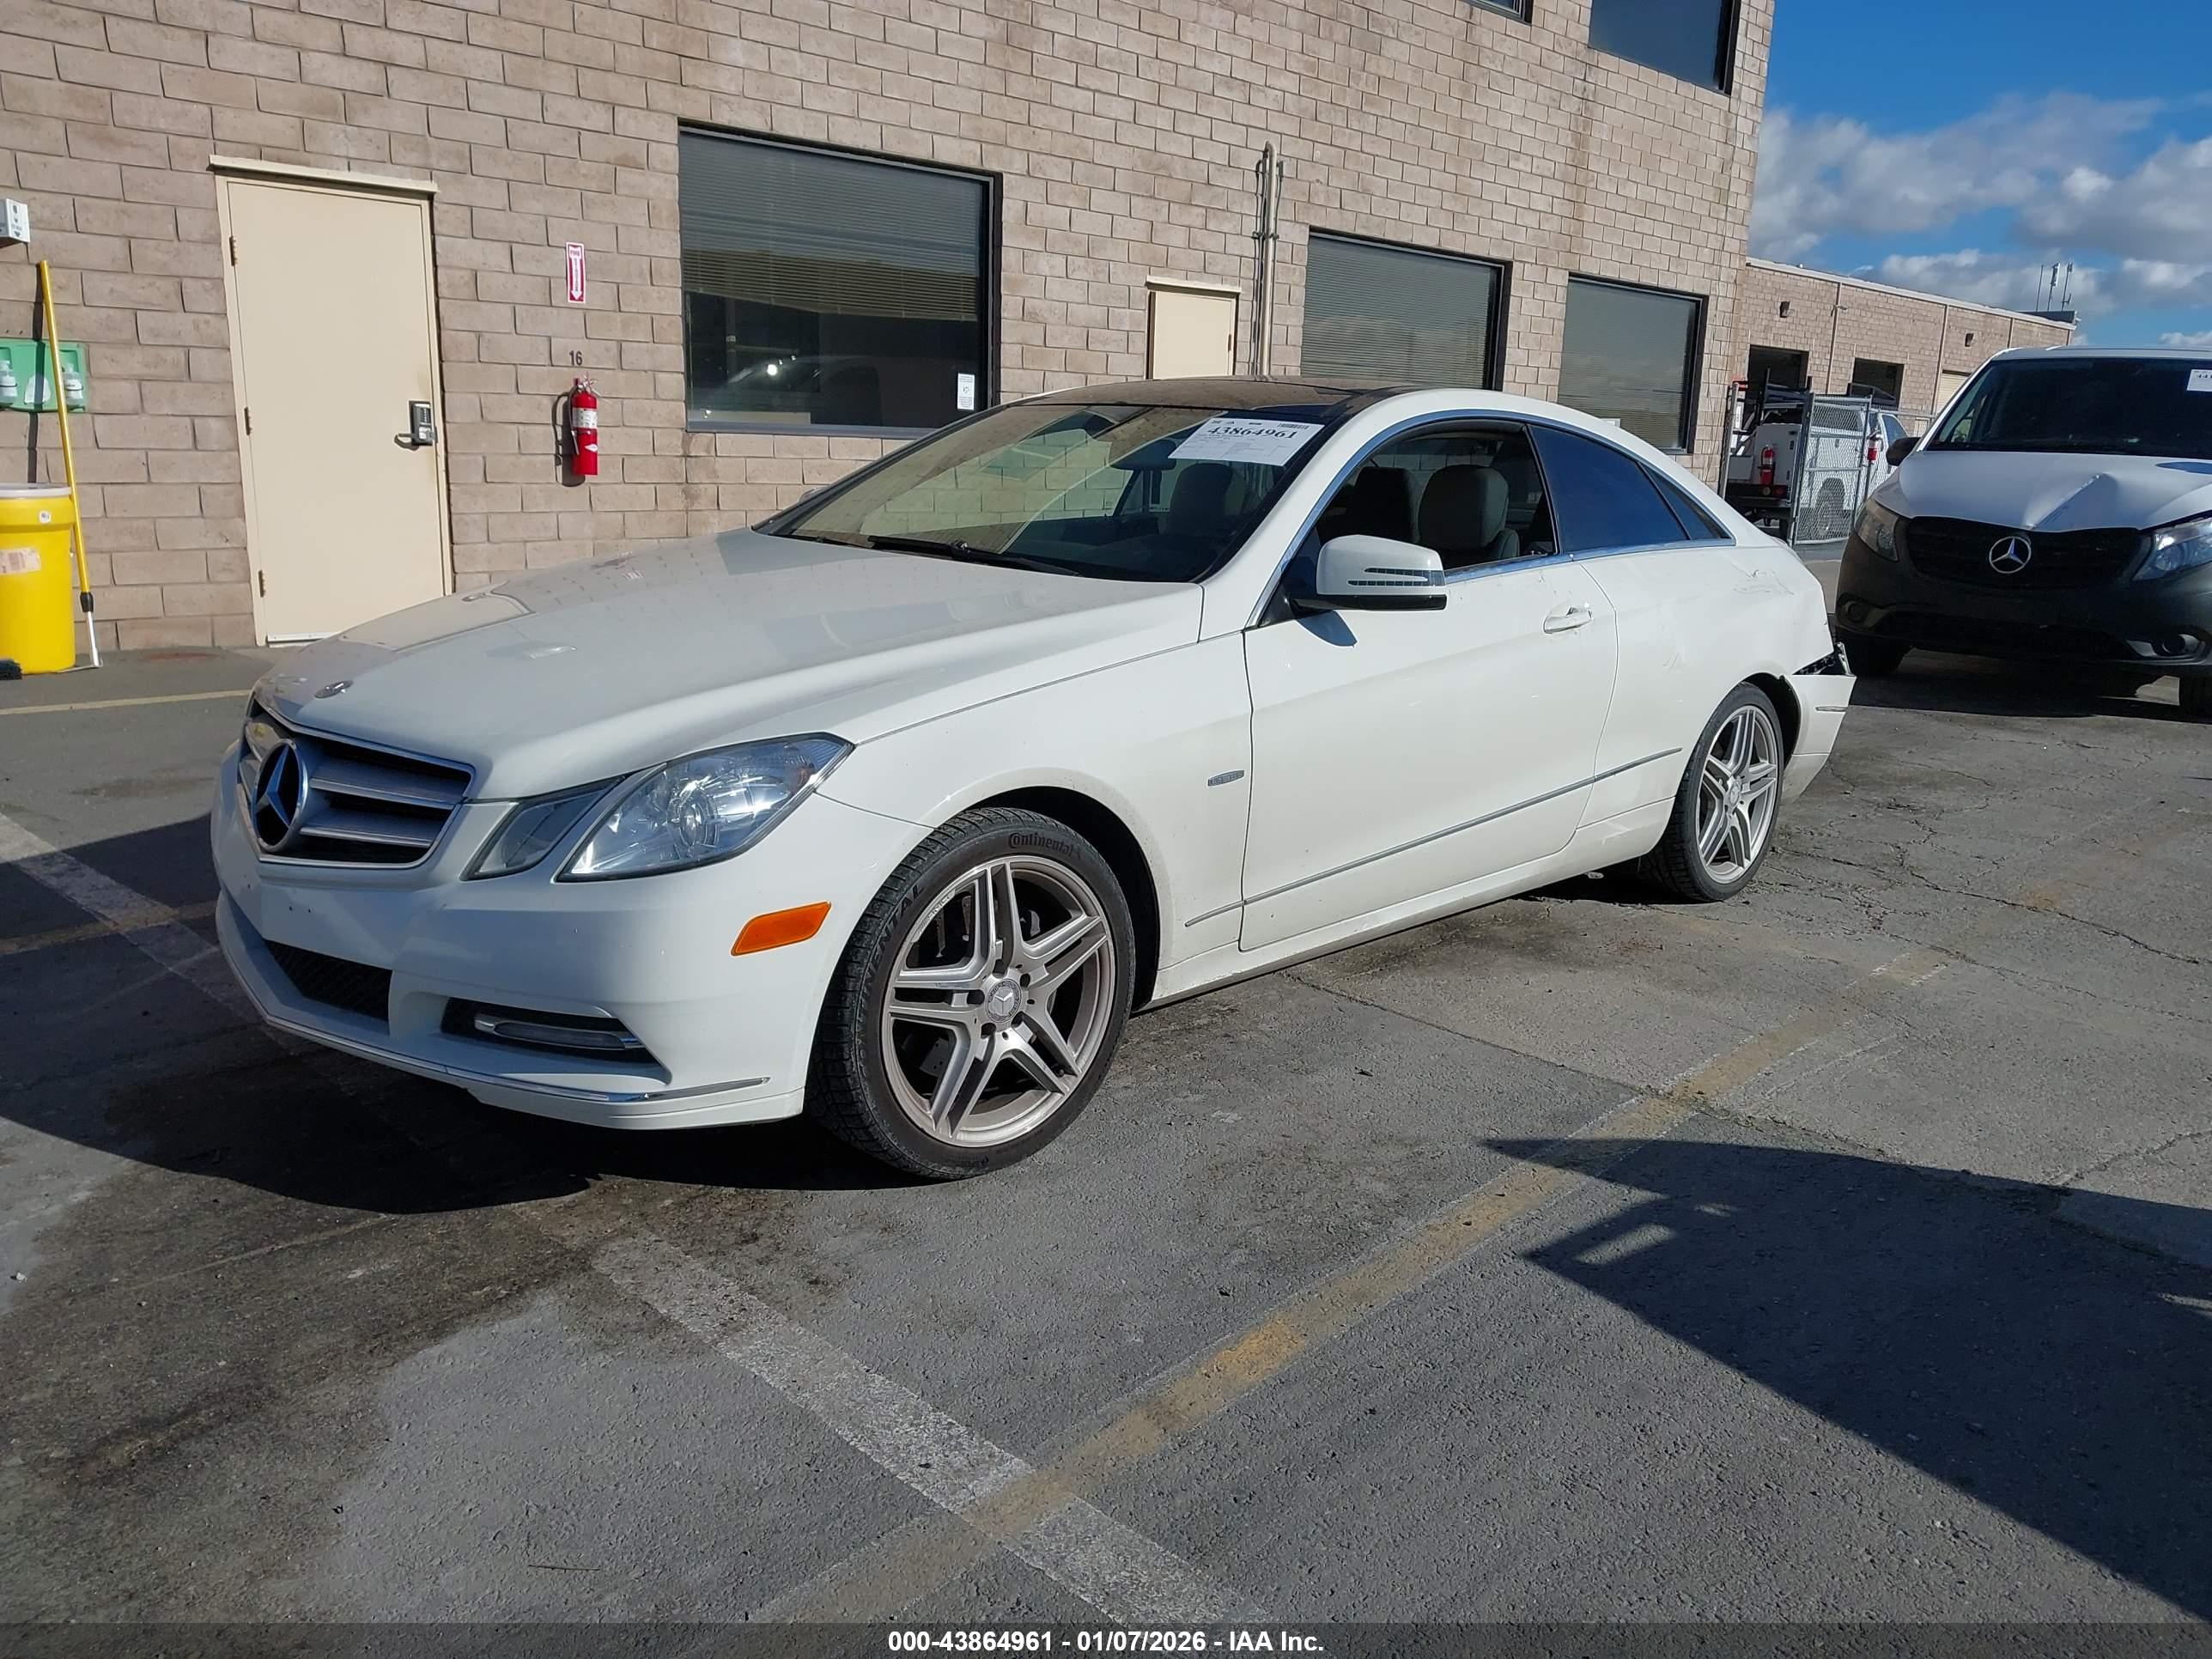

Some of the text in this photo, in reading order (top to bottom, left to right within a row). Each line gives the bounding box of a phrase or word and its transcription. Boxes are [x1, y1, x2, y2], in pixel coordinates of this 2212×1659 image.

[569, 349, 583, 366] 16
[1206, 426, 1298, 439] 43864961
[1008, 832, 1074, 857] Continental
